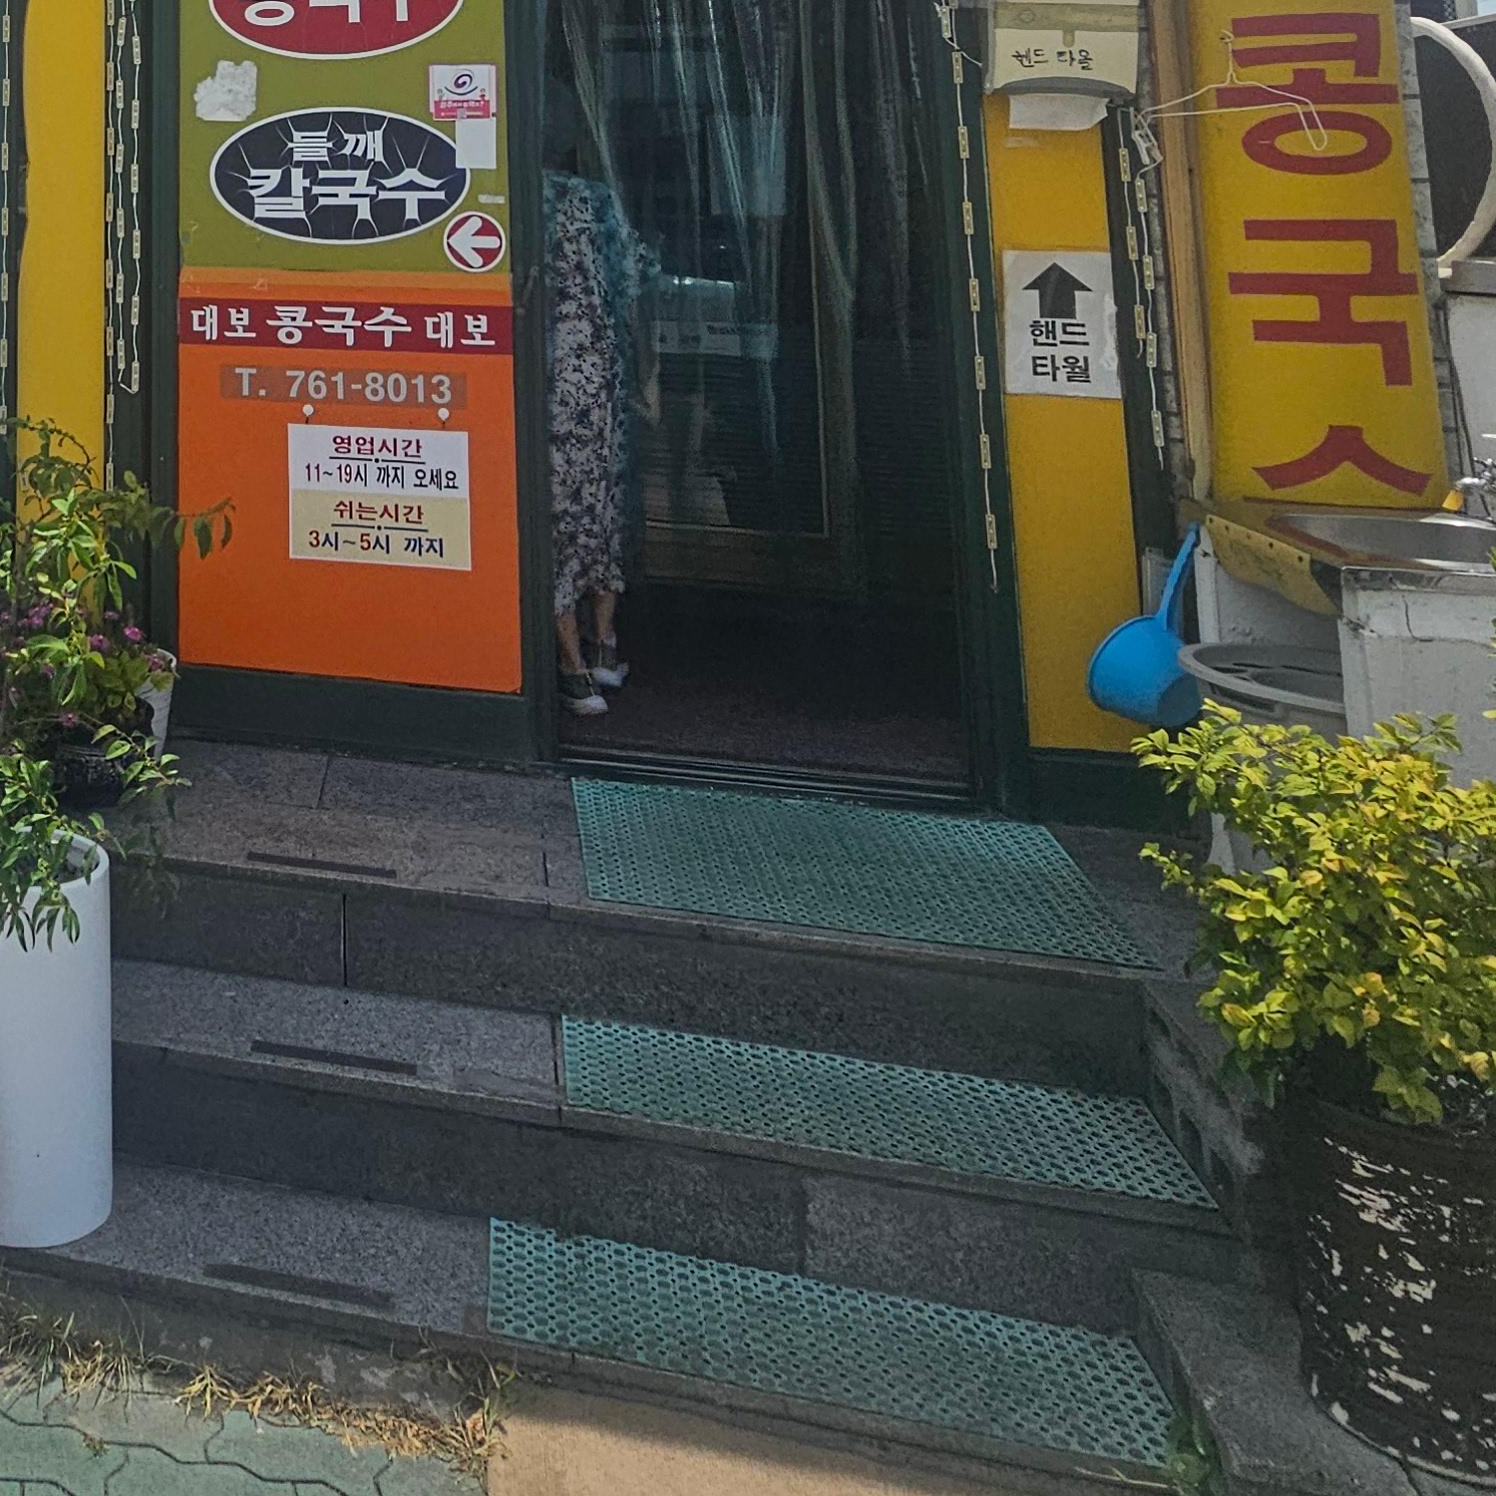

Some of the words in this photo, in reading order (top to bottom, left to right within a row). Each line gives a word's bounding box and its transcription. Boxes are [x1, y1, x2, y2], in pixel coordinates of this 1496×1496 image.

[287, 129, 386, 163] 들깨
[246, 166, 447, 221] 칼국수
[190, 304, 257, 341] 대보
[266, 305, 413, 348] 콩국수
[424, 311, 496, 349] 대보
[1029, 320, 1091, 348] 핸드
[1031, 354, 1092, 384] 타월
[234, 367, 267, 398] T.
[285, 369, 453, 405] 761-8013
[331, 435, 423, 459] 영업시간
[305, 463, 369, 488] 11~19시
[376, 464, 406, 490] 까지
[412, 468, 460, 491] 오세요
[333, 500, 424, 525] 쉬는시간
[308, 530, 391, 555] 3시~5시
[403, 537, 445, 558] 까지
